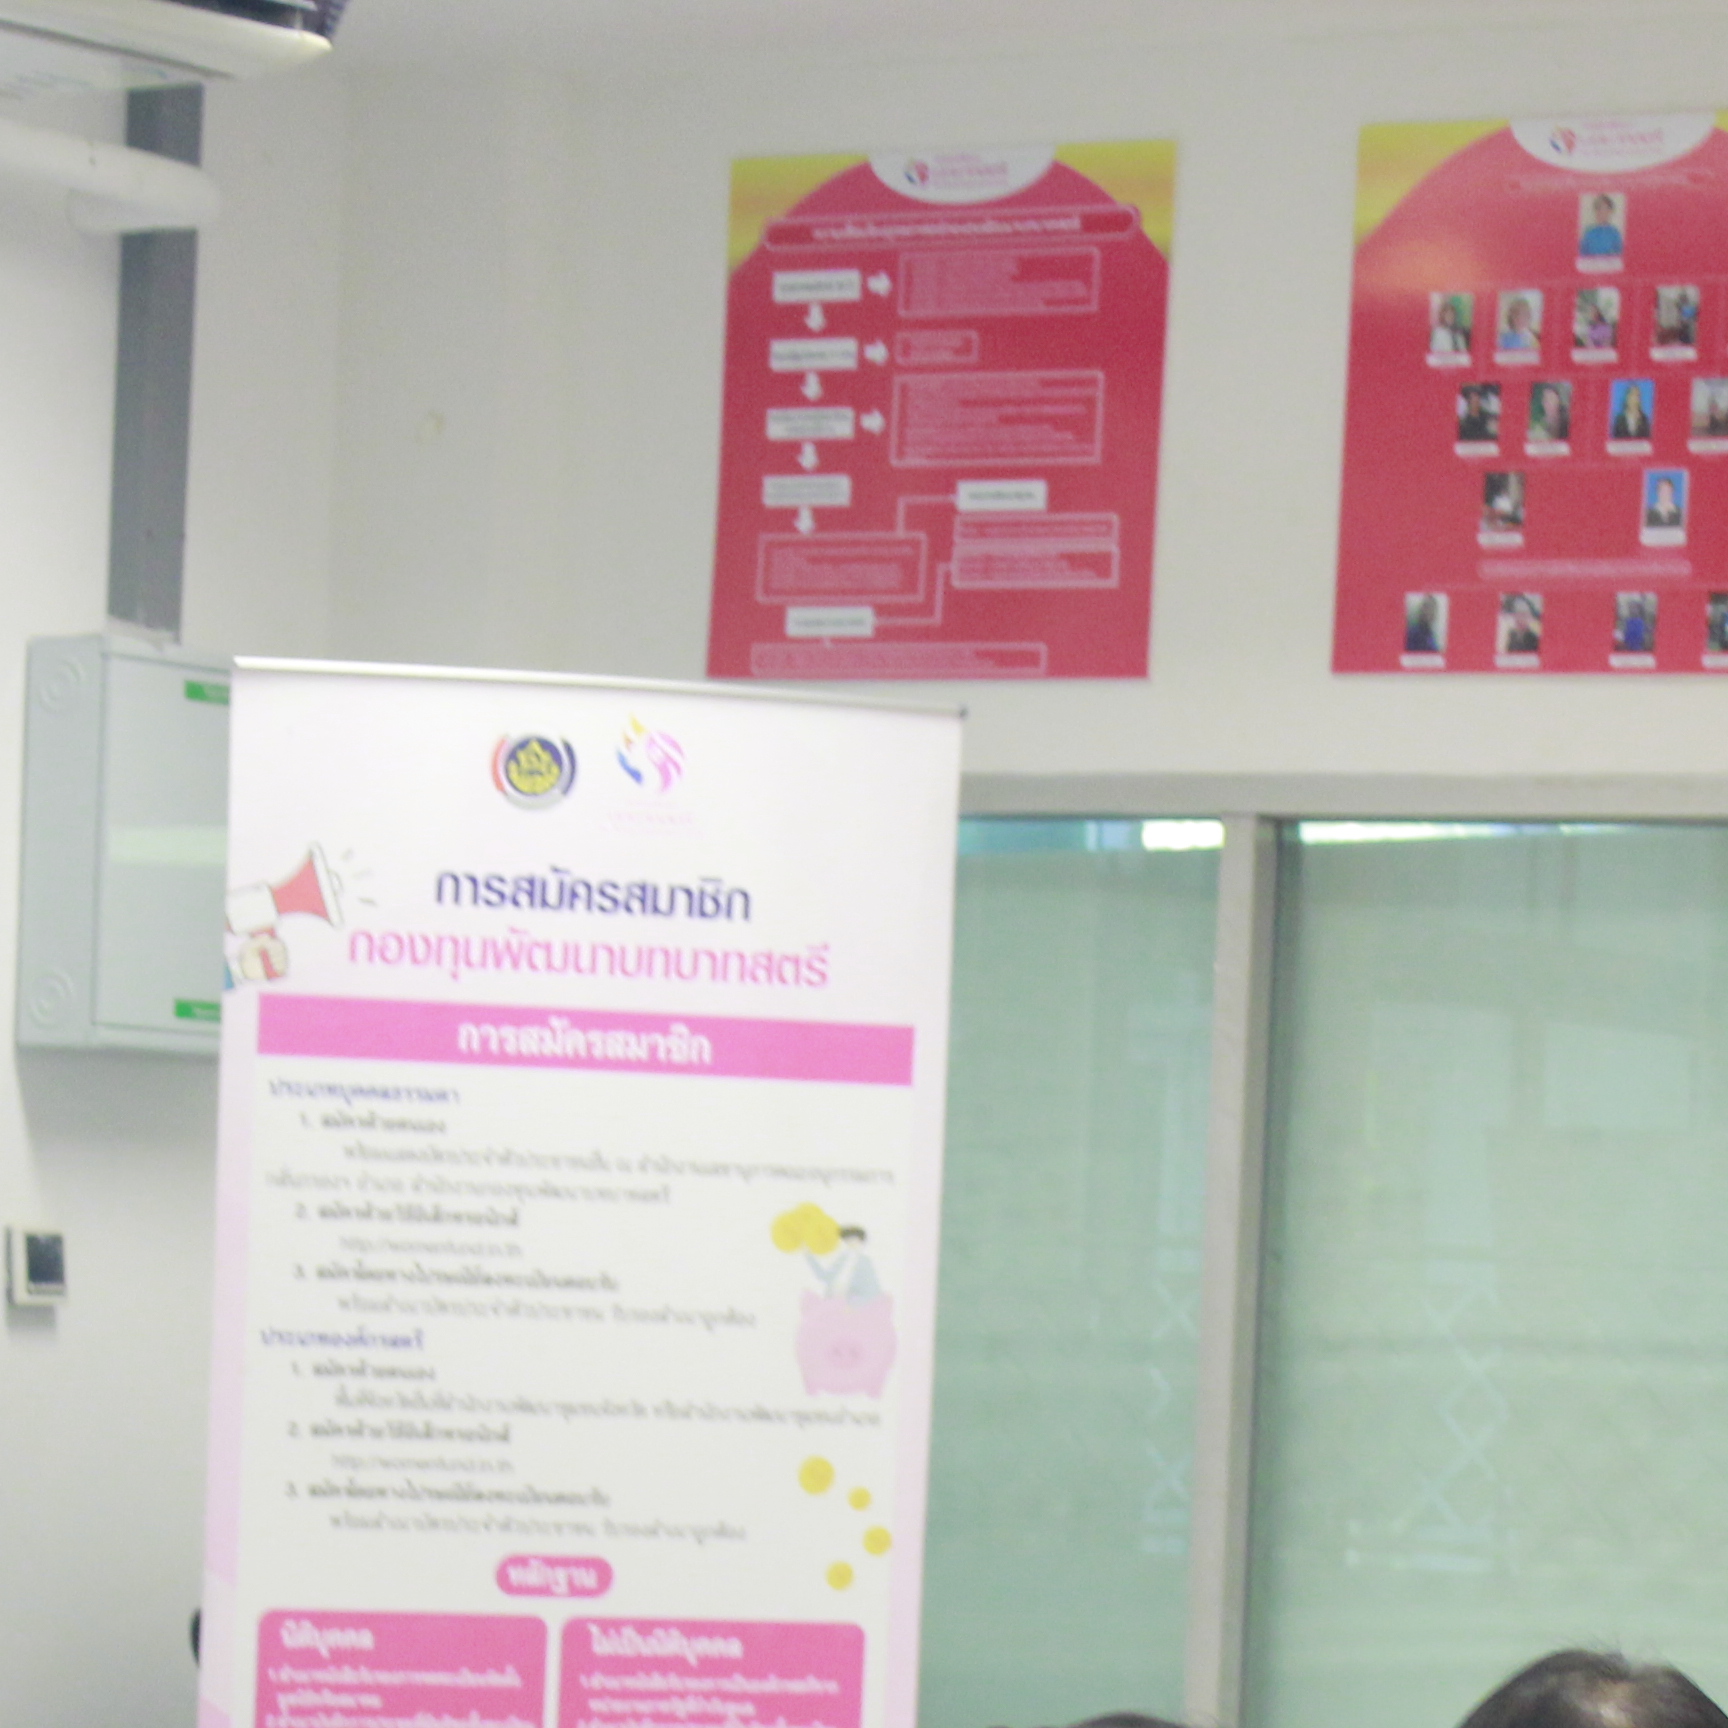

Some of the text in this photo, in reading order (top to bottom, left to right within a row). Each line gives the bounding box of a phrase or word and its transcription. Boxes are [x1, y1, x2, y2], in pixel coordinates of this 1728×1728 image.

[435, 864, 752, 924] การสมัครสมาชิก
[347, 925, 832, 989] กองทุนพัฒนาบทบาทสตรี
[456, 1016, 714, 1067] การสมัครสมาชิก
